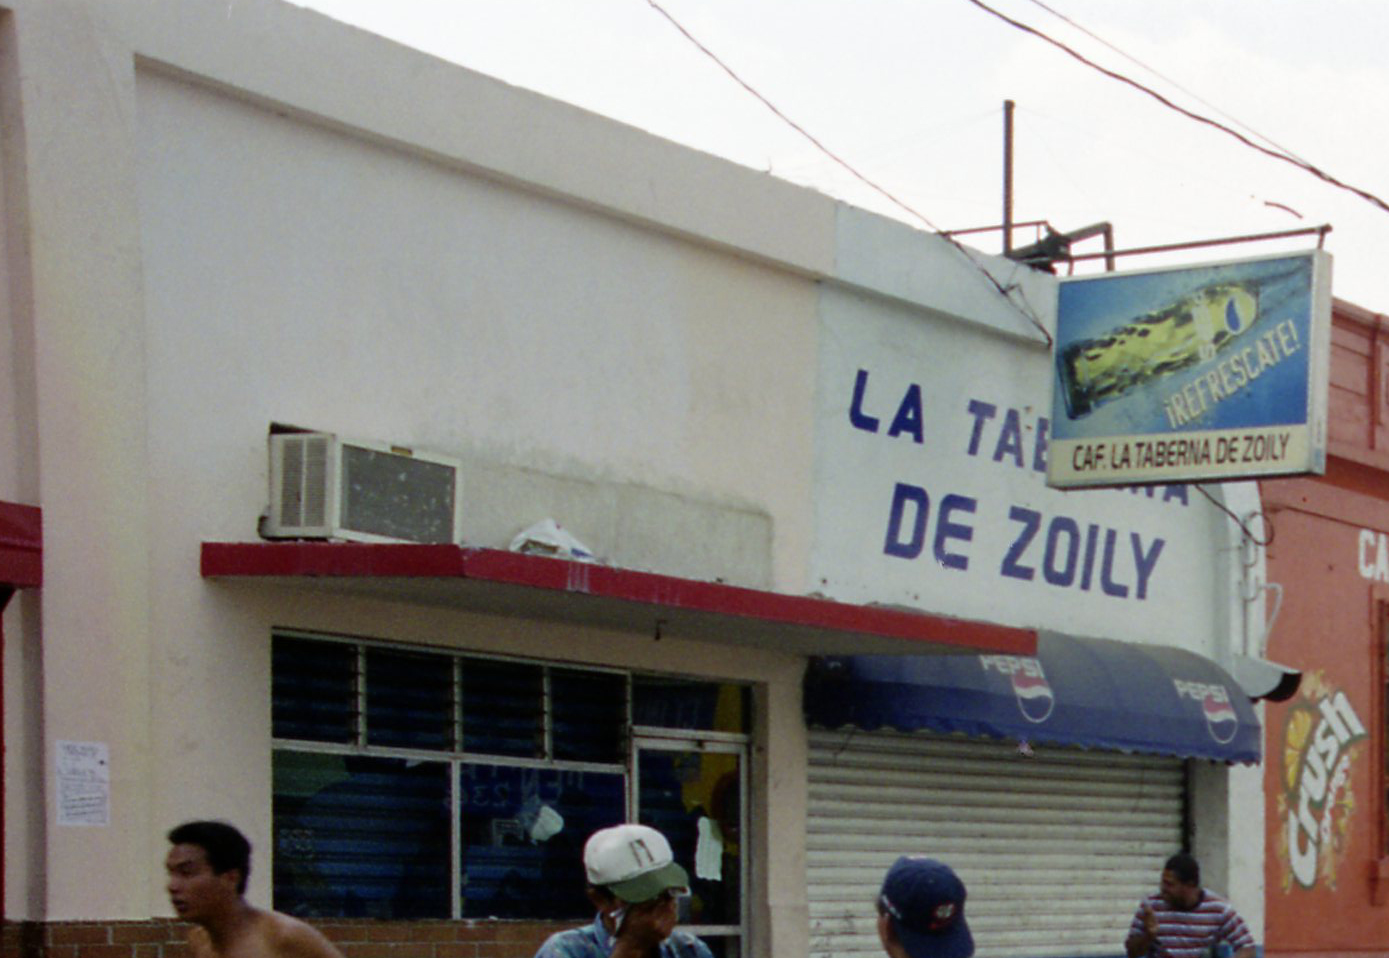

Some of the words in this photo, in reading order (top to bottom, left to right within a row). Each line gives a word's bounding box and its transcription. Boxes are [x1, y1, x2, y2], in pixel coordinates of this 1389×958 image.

[849, 368, 924, 444] LA
[1072, 444, 1105, 471] CAF.
[1111, 443, 1132, 470] LA
[1134, 438, 1211, 469] TABERNA
[1216, 437, 1239, 464] DE
[1242, 433, 1291, 463] ZOILY
[883, 482, 978, 571] DE
[1000, 505, 1166, 600] ZOILY
[978, 654, 1045, 679] PEPSI
[1172, 678, 1230, 703] PEPSI
[1287, 690, 1368, 888] Crush
